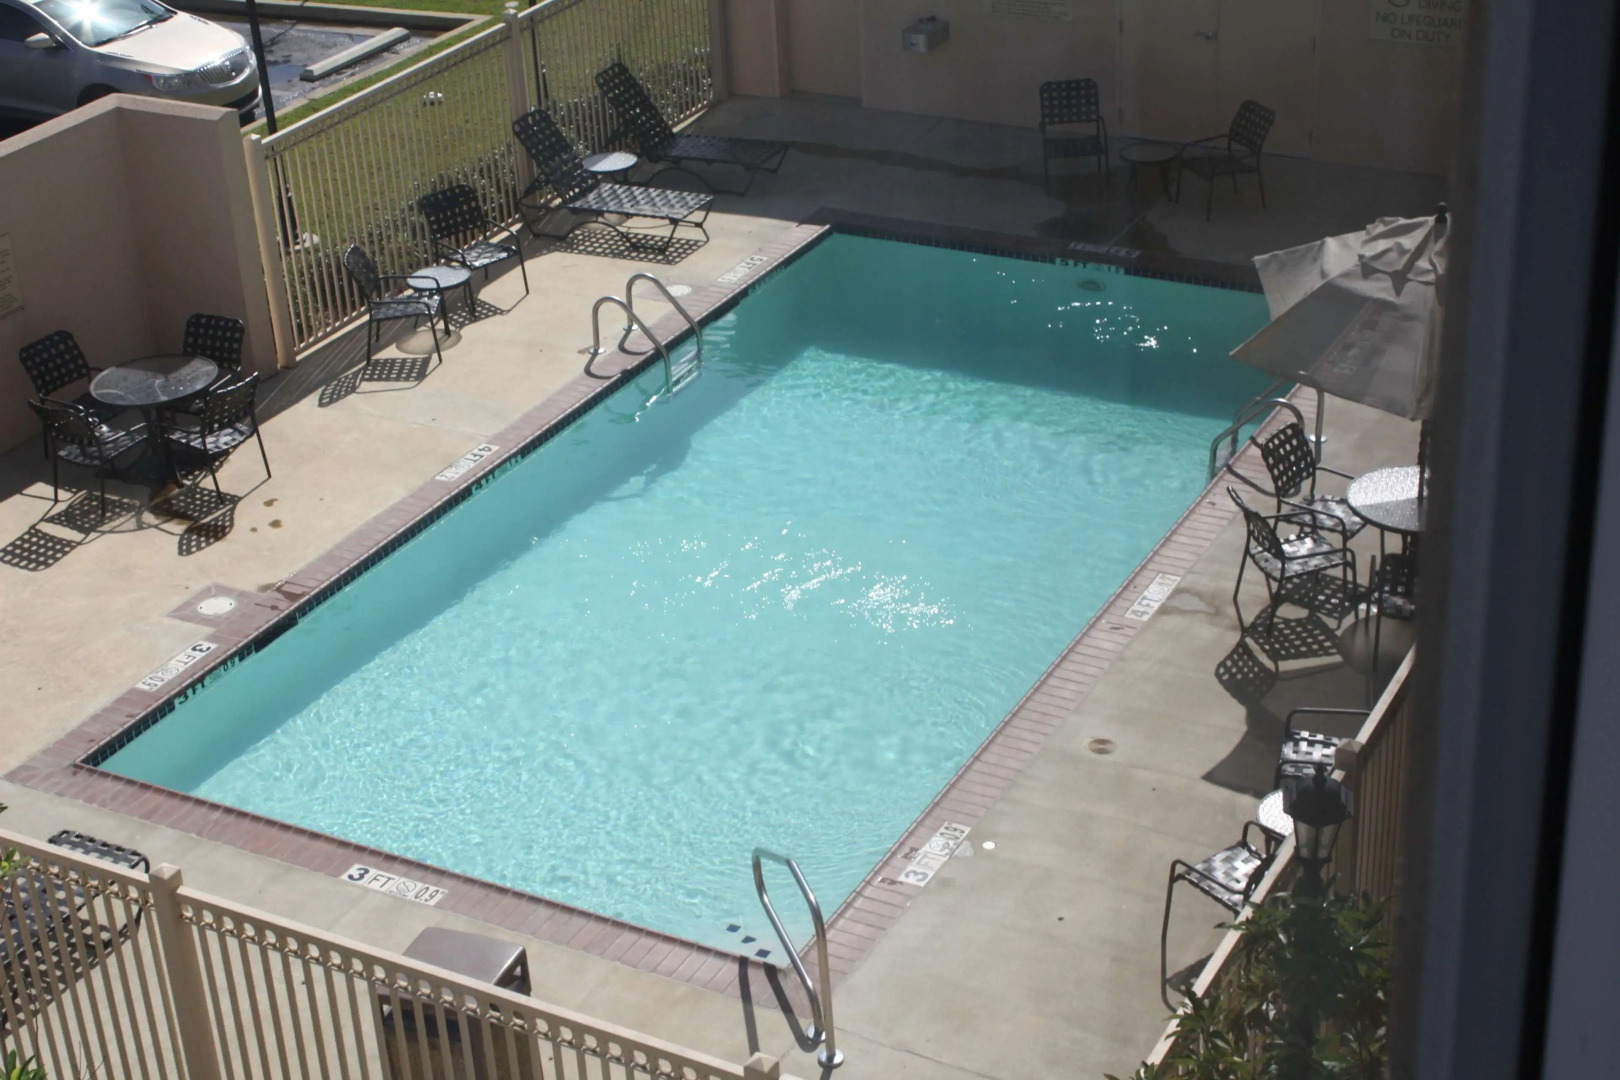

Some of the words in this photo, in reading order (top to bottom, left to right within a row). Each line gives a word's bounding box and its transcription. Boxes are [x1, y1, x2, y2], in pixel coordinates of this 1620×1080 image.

[1375, 11, 1397, 25] NO
[1390, 27, 1412, 40] ON
[1416, 29, 1452, 42] DUTY
[1137, 595, 1163, 609] FT
[1131, 609, 1150, 618] 4
[191, 643, 212, 653] 3
[175, 653, 197, 666] FT
[347, 867, 370, 882] 3
[367, 873, 396, 889] FT
[904, 869, 930, 883] 3
